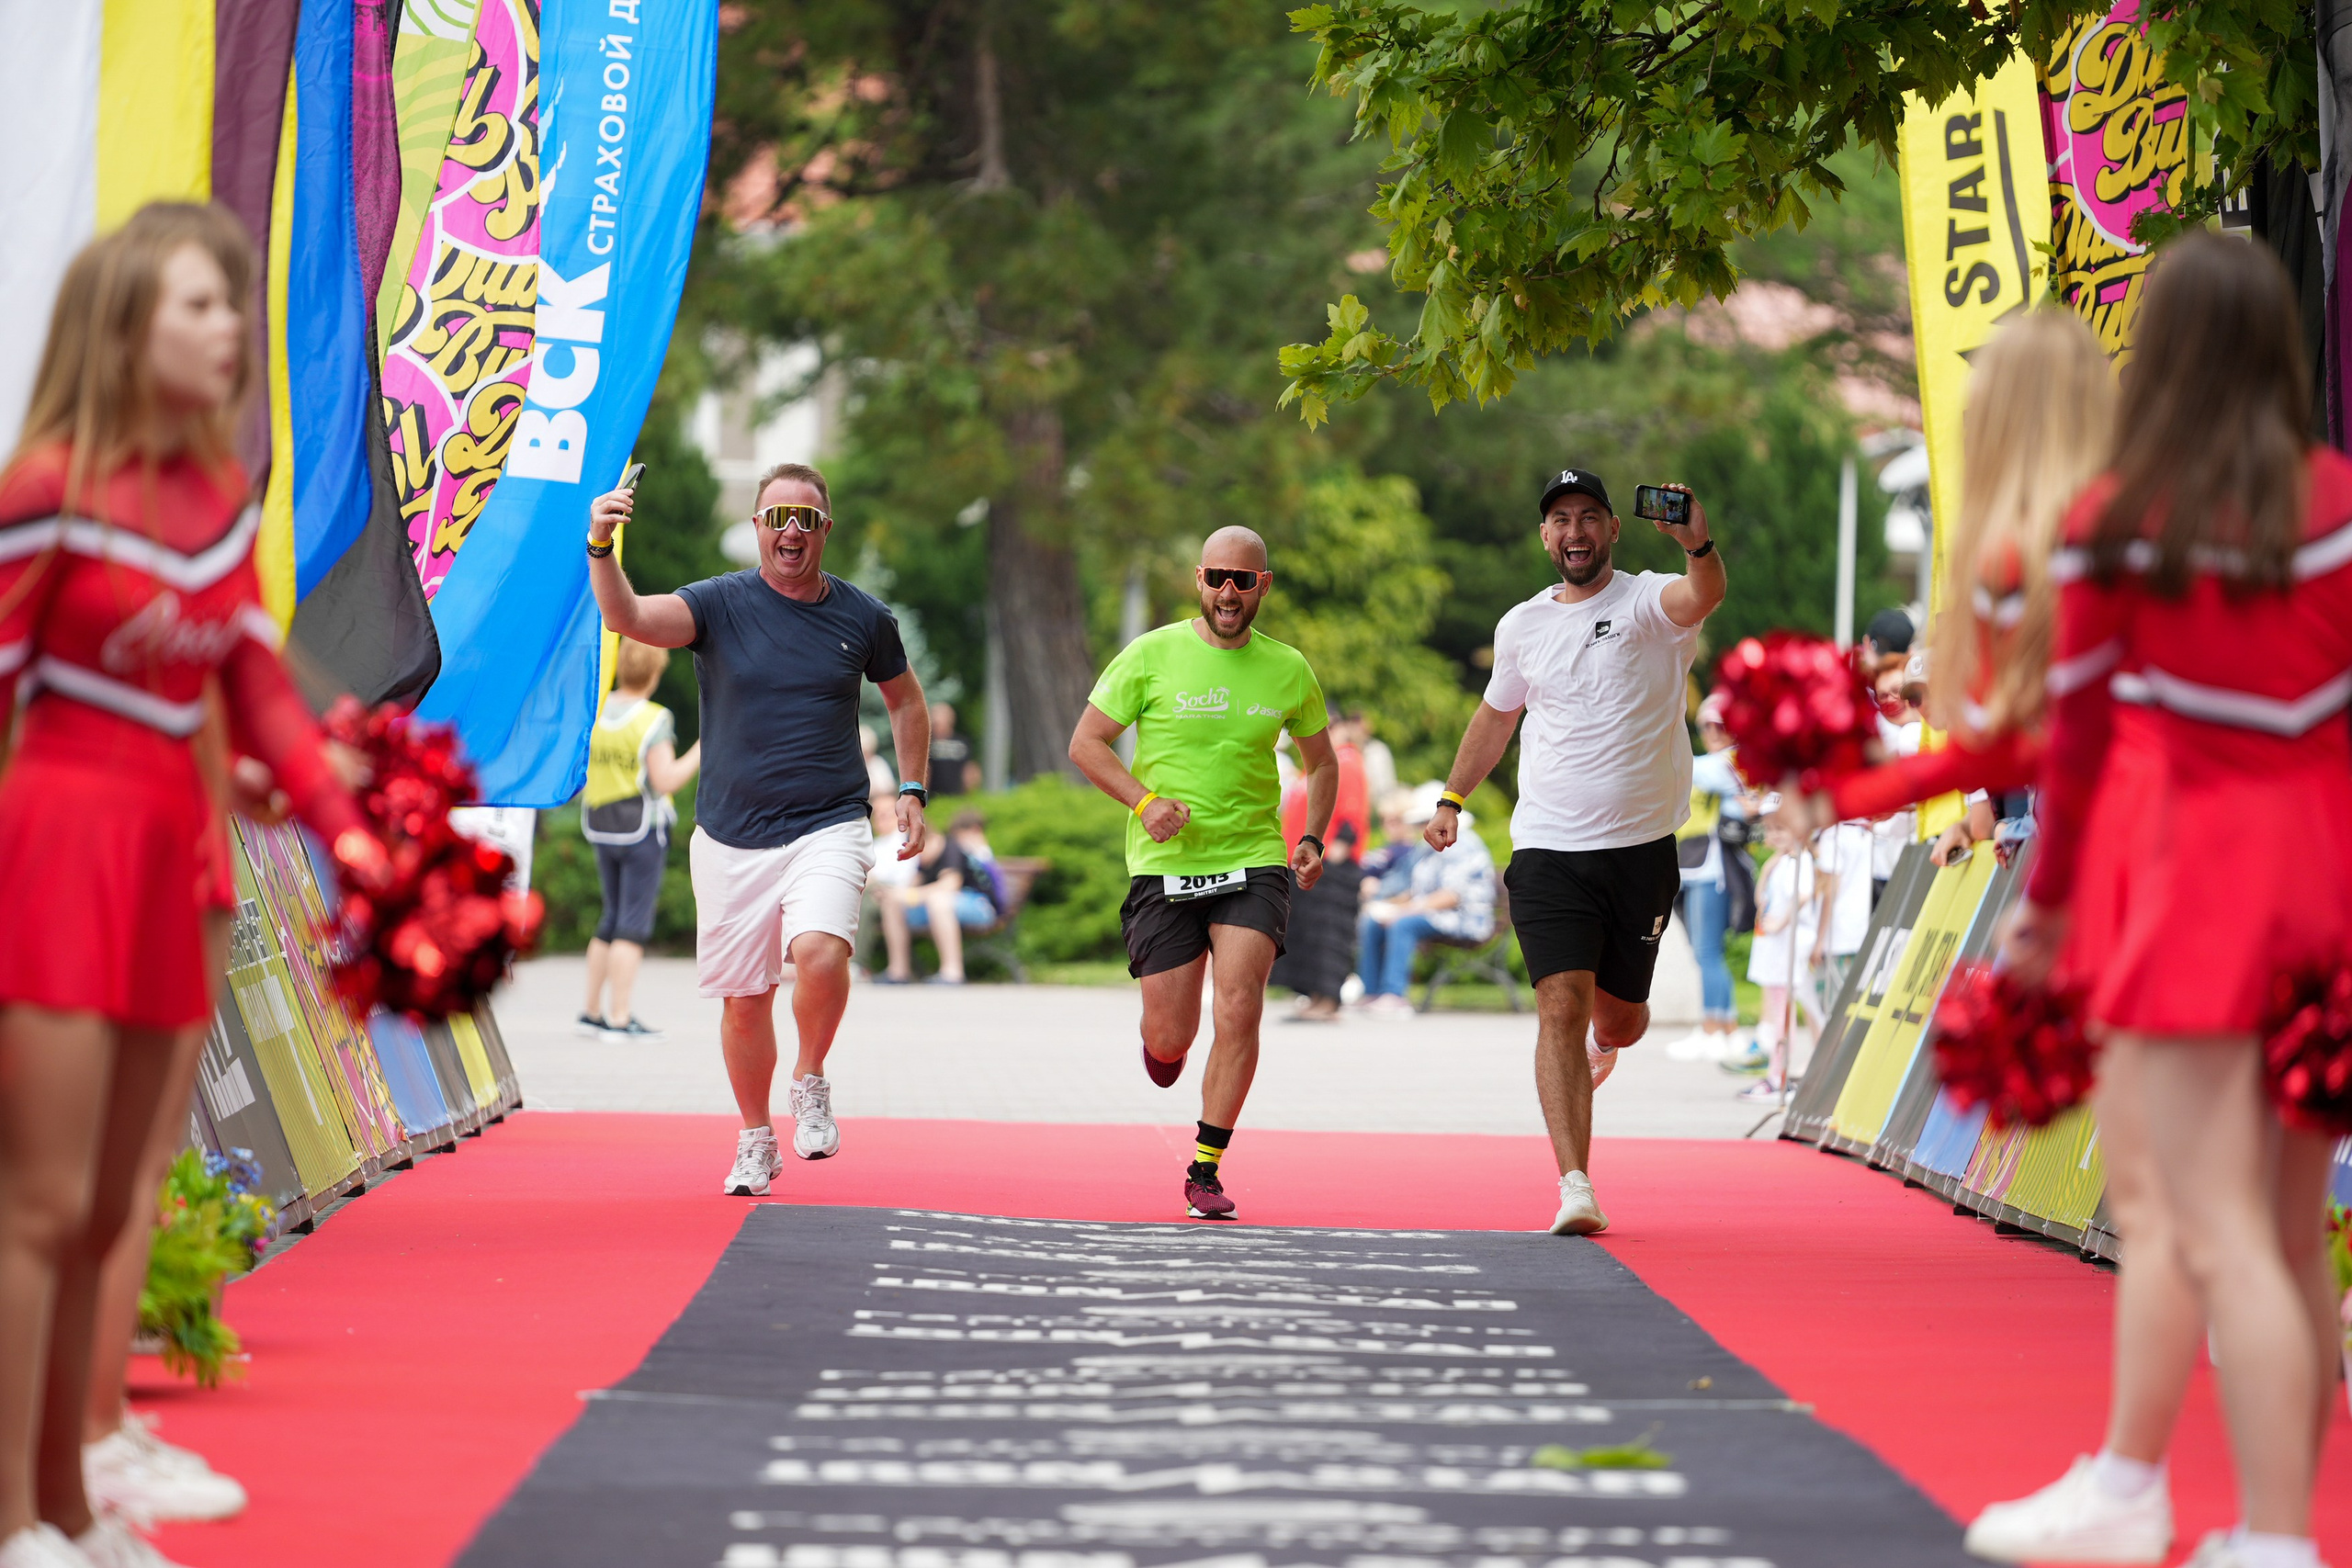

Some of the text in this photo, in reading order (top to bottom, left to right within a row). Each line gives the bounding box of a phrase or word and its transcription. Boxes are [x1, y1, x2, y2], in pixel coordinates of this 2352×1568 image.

[587, 34, 633, 255] СТРАХОВОЙ
[506, 257, 611, 484] ВСК
[1561, 470, 1577, 483] LA
[1173, 687, 1229, 712] Sochi
[1260, 706, 1283, 719] asics
[1180, 872, 1229, 890] 2013
[1193, 887, 1217, 897] DMITRIY
